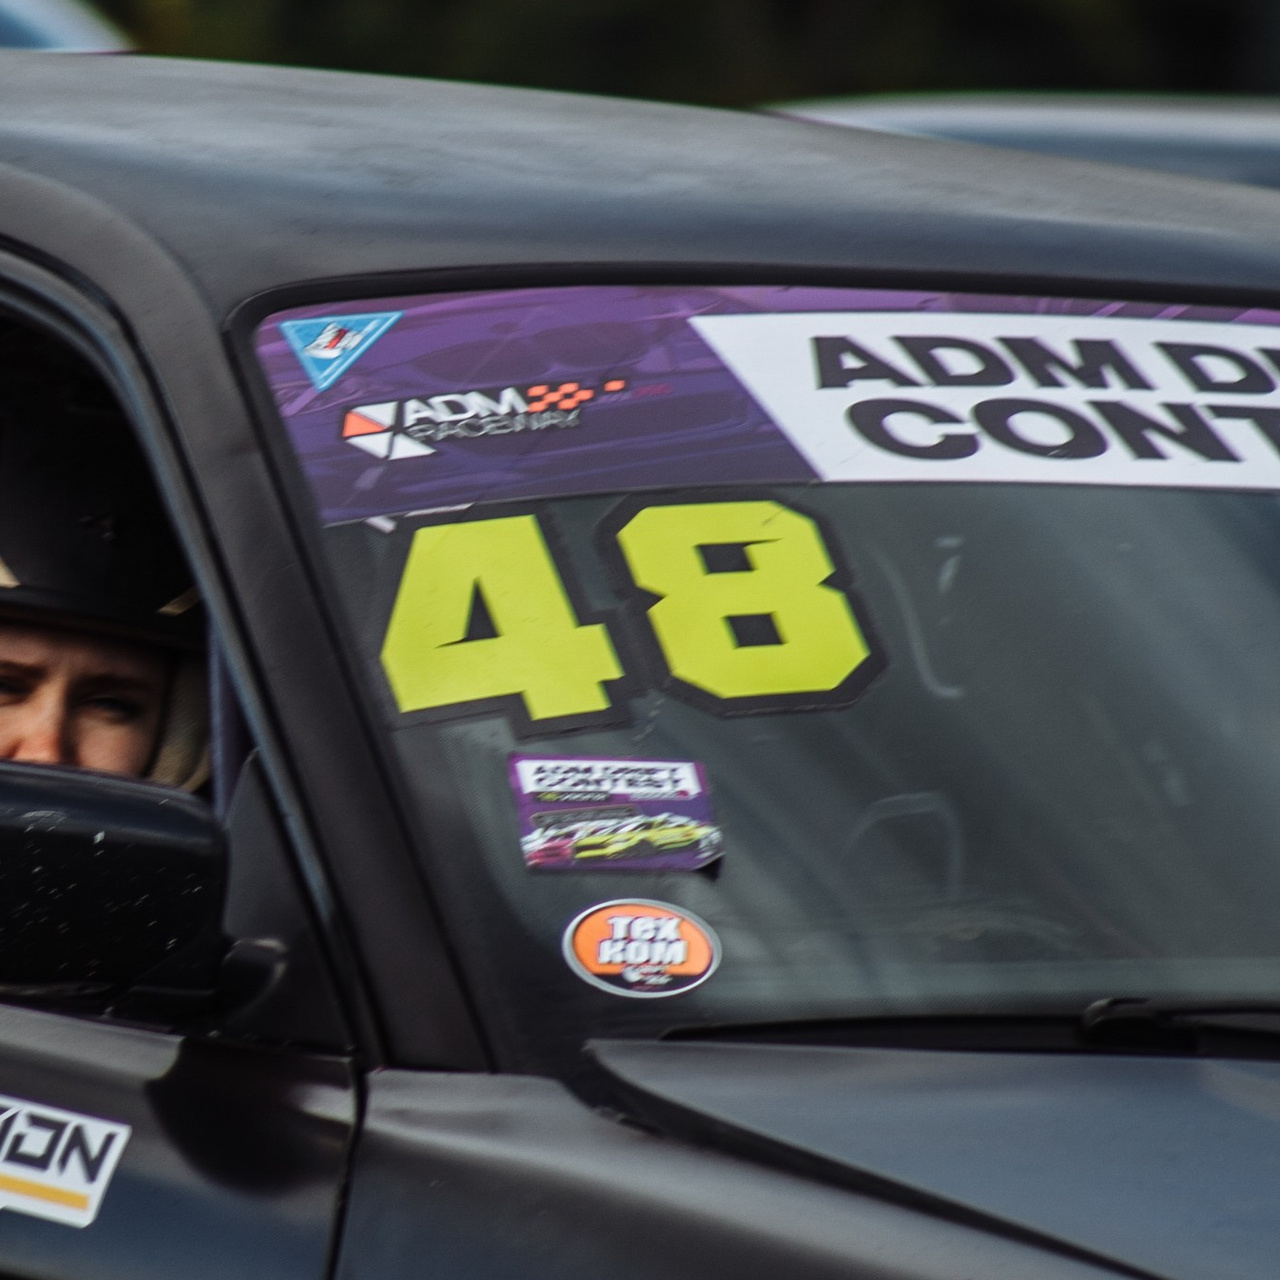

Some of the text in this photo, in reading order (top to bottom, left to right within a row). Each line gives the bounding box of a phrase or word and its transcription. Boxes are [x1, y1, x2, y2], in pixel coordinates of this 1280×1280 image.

[810, 335, 1280, 396] ADM D
[402, 387, 530, 428] ADM
[380, 500, 871, 721] 48
